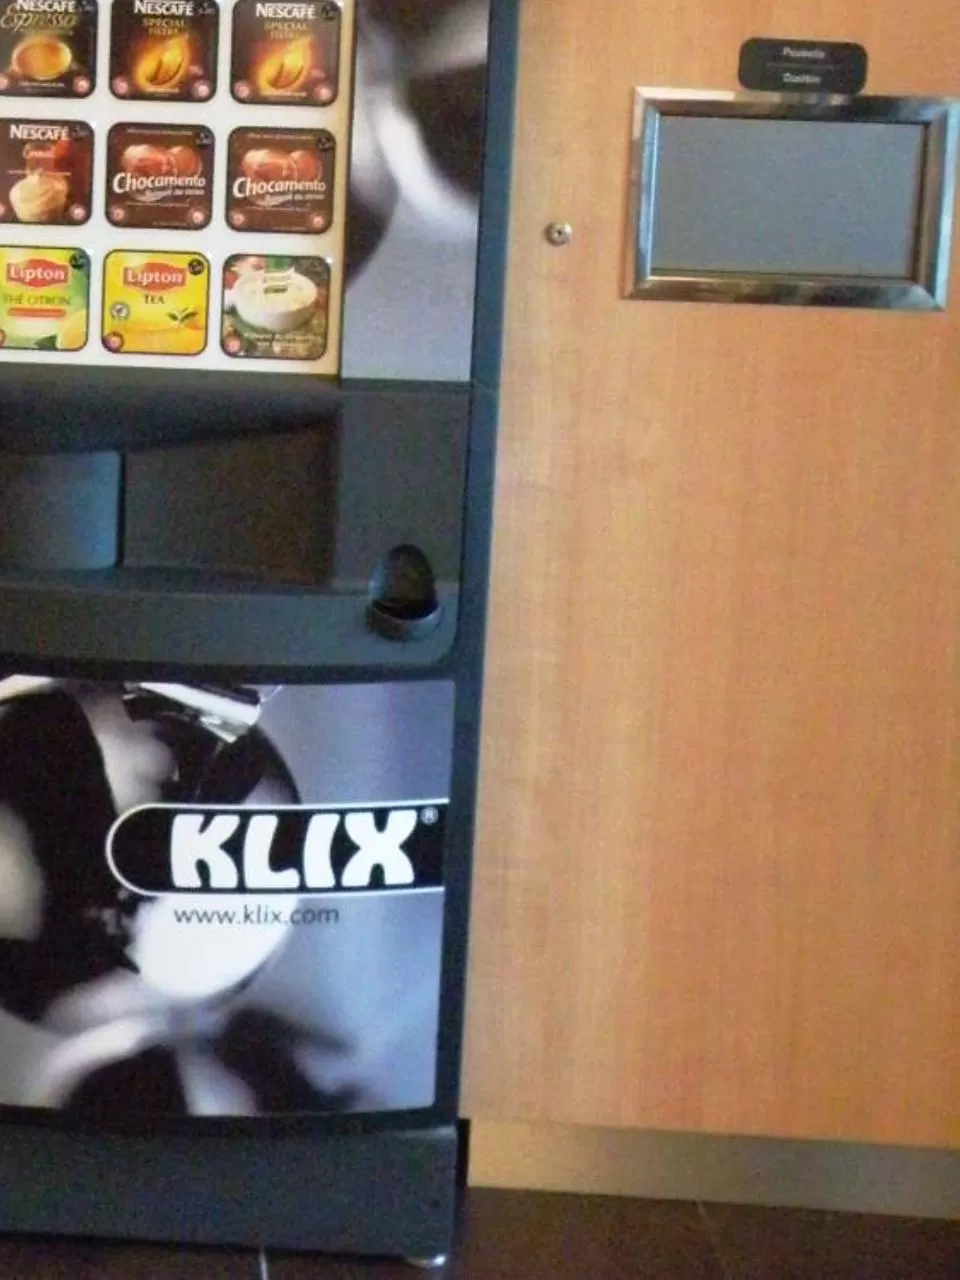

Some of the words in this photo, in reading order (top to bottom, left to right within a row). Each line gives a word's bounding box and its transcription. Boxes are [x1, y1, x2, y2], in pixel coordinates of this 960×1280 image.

[113, 172, 206, 194] Chocamento
[232, 177, 326, 198] Chocamento
[10, 265, 65, 282] Lipton
[127, 268, 183, 286] Lipton
[143, 293, 165, 304] TEA
[170, 809, 418, 889] KLIX
[174, 904, 340, 926] www.klix.com
